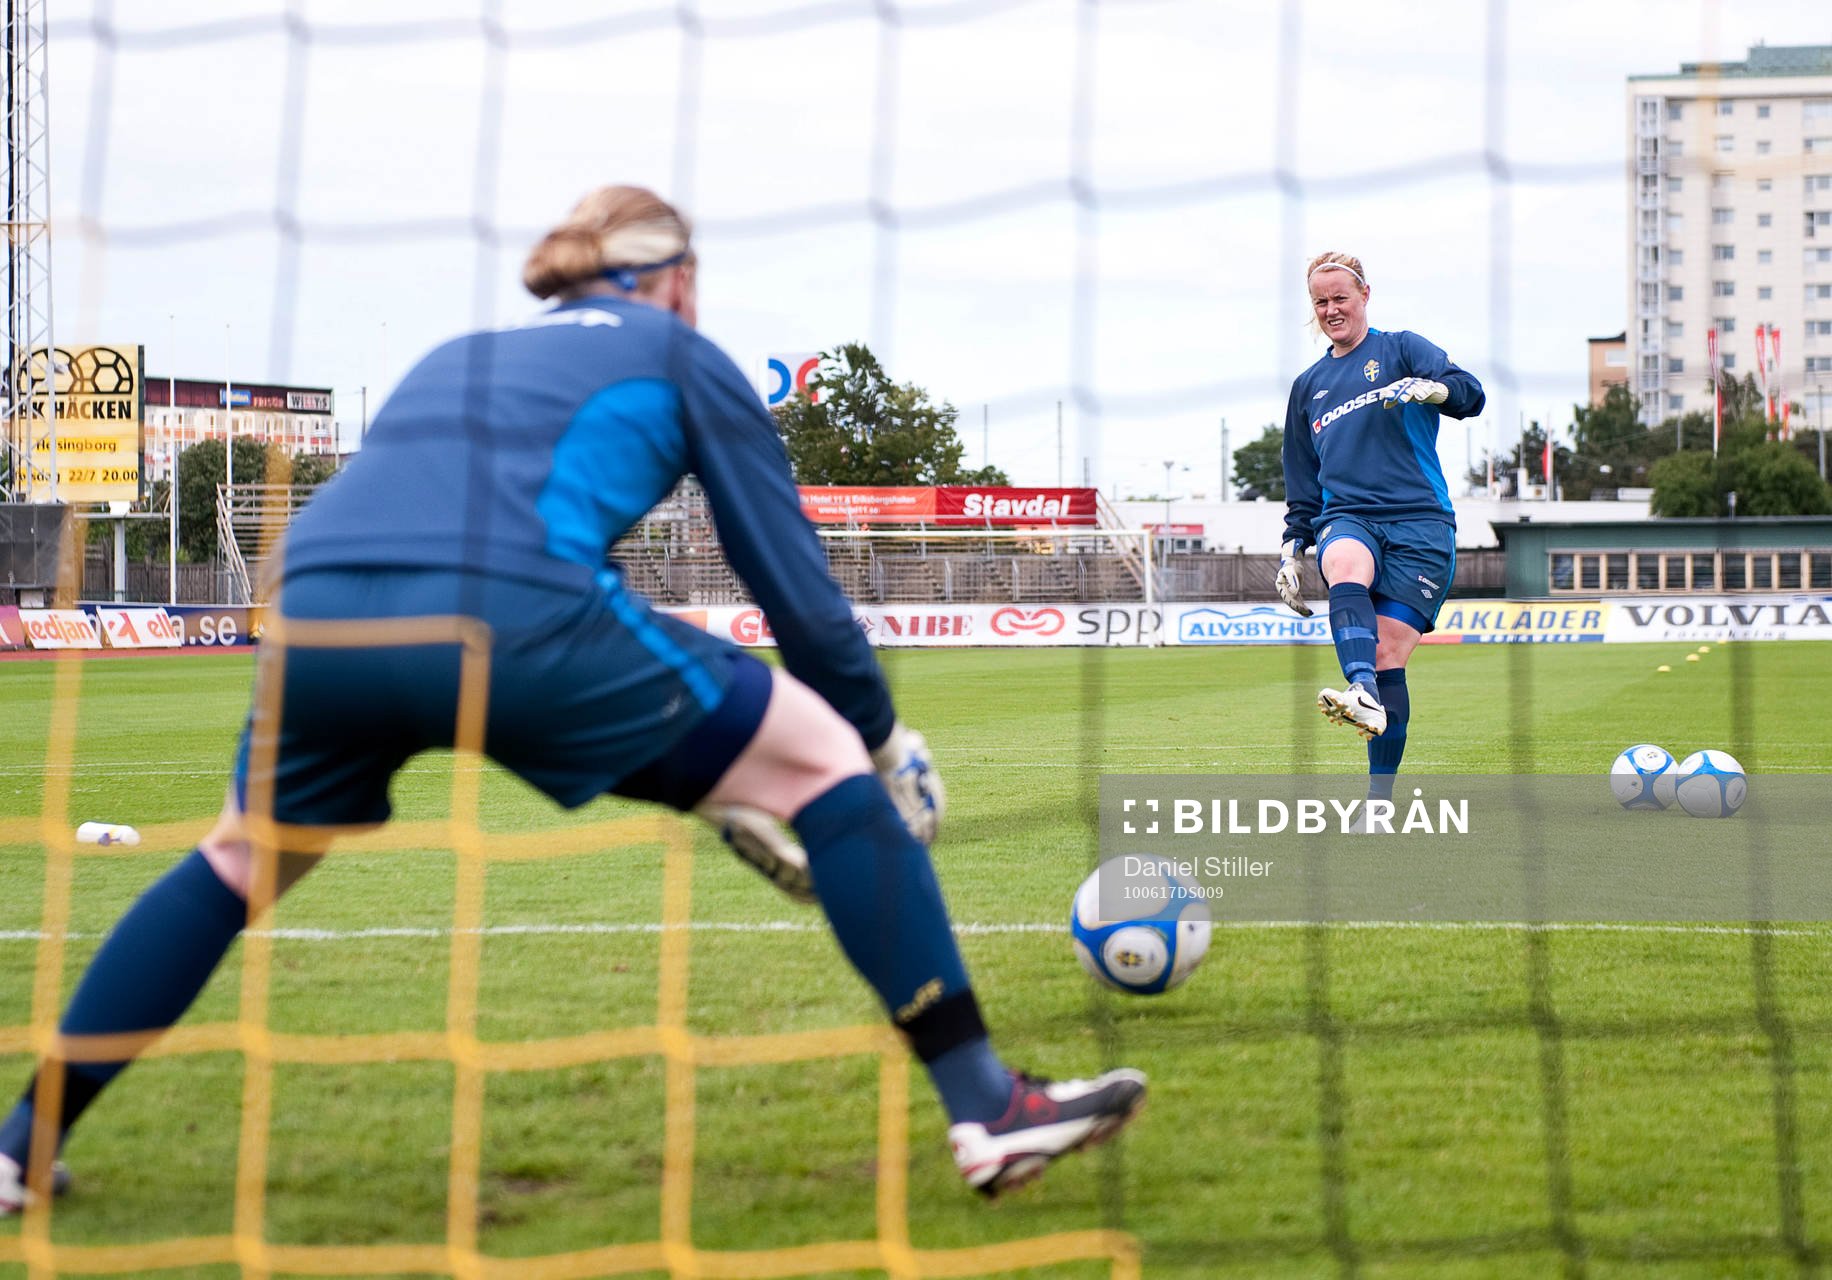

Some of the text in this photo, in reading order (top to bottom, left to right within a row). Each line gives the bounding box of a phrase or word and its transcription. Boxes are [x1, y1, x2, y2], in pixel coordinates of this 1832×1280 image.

[54, 396, 132, 420] HÄCKEN
[102, 471, 138, 481] 20.00
[963, 494, 1070, 518] Stavdal
[880, 615, 973, 636] NIBE
[1076, 609, 1162, 643] spp
[1621, 605, 1832, 626] VOLVIA
